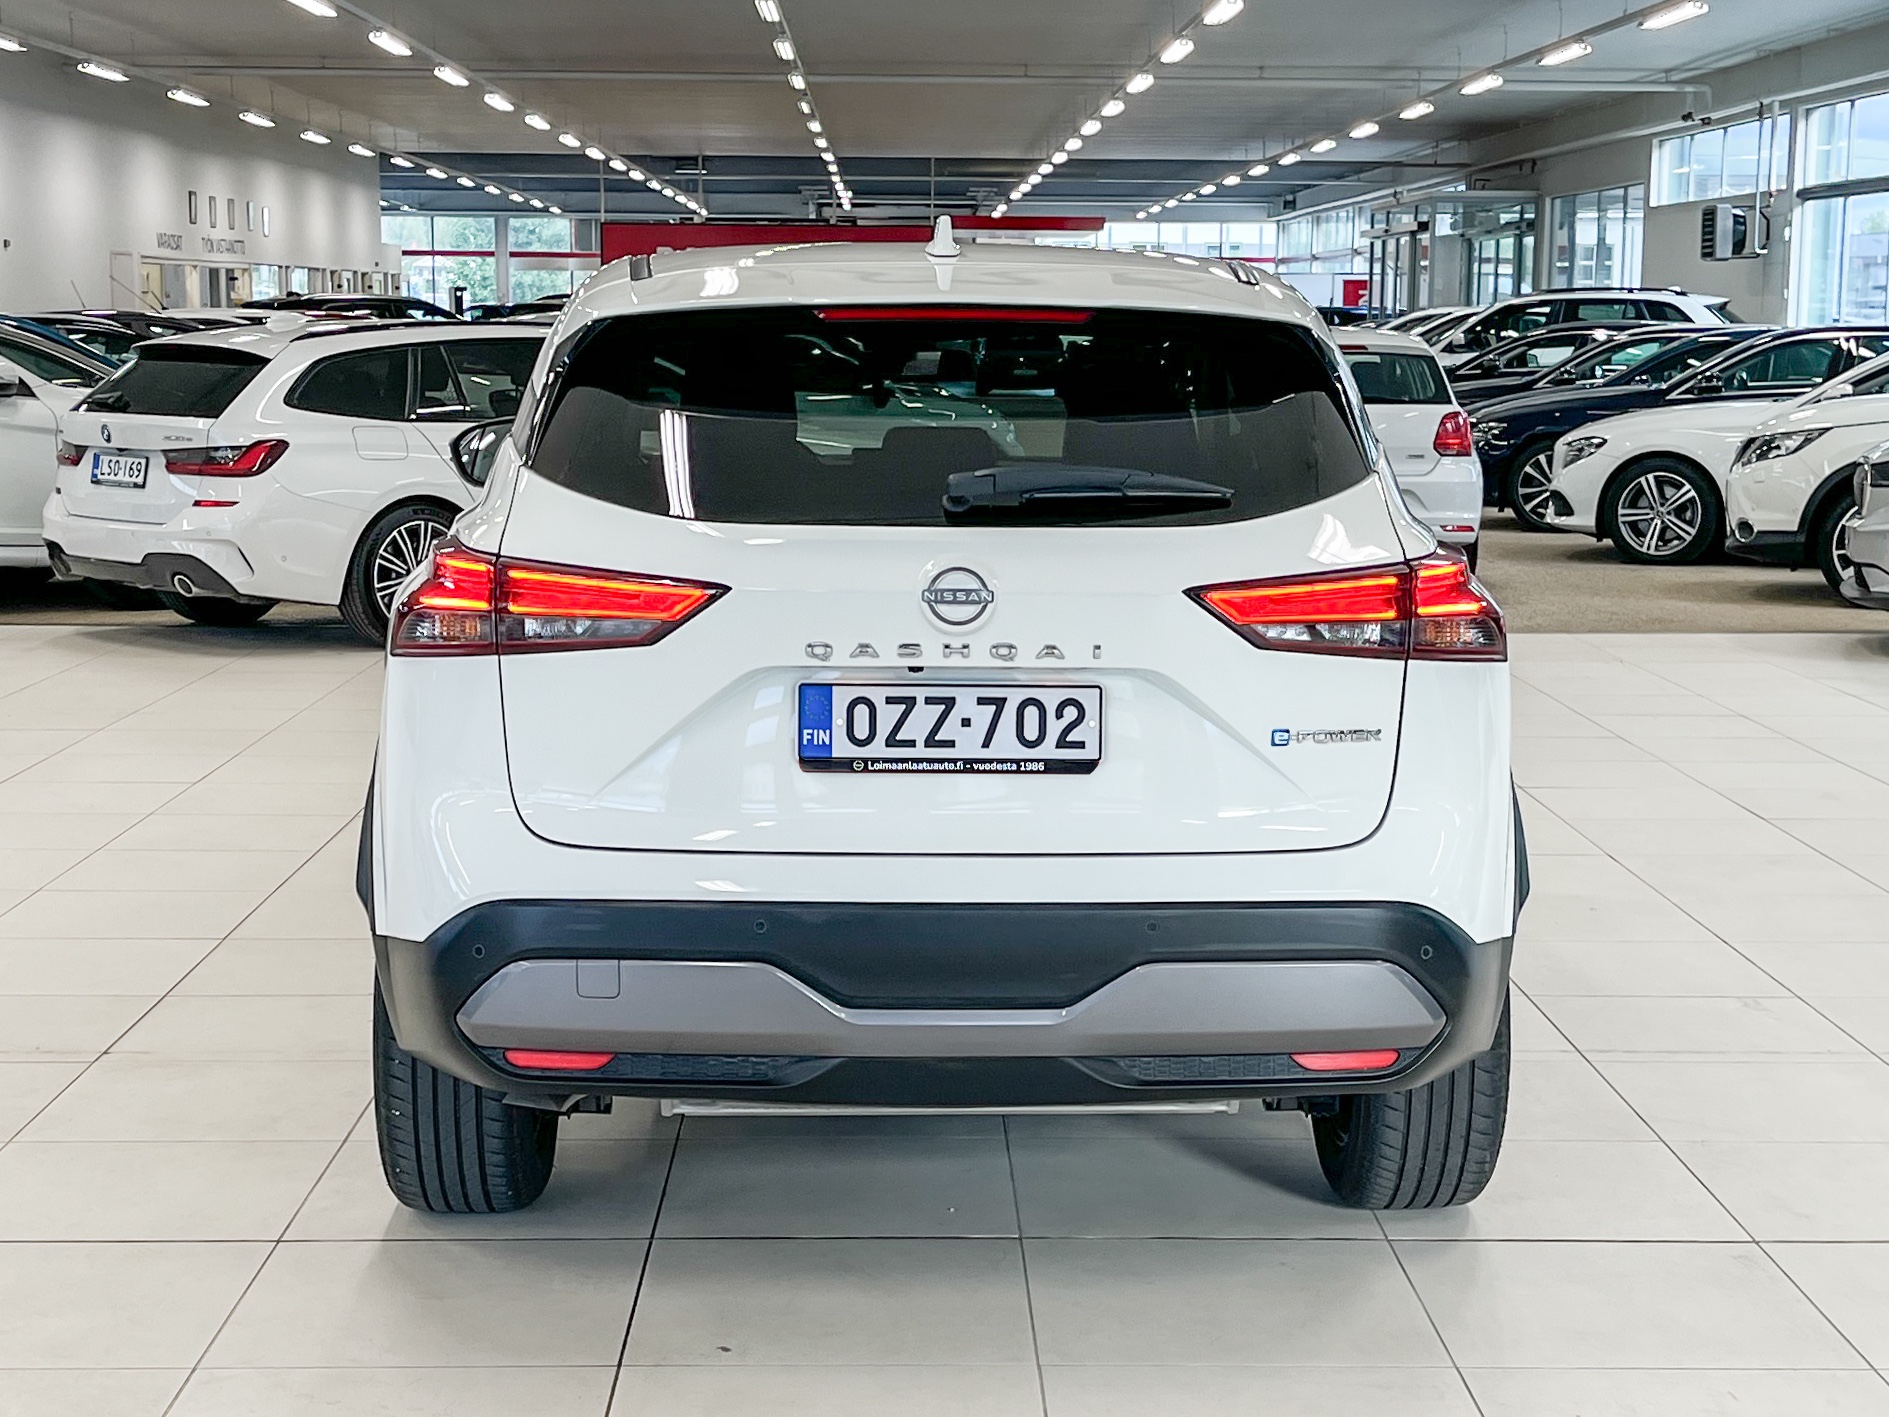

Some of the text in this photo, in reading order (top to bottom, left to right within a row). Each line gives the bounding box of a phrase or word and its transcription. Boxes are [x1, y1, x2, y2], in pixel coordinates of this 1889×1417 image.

[100, 458, 142, 479] LSO-169
[923, 590, 993, 602] NISSAN
[804, 641, 1102, 661] QASHQAI
[846, 696, 1086, 749] OZZ-702
[802, 729, 830, 745] FIN
[1271, 728, 1382, 746] e-POWER
[867, 760, 964, 771] Loimaanlaatuauto.fi
[973, 761, 1017, 771] vuodesta
[1019, 761, 1045, 771] 1986
